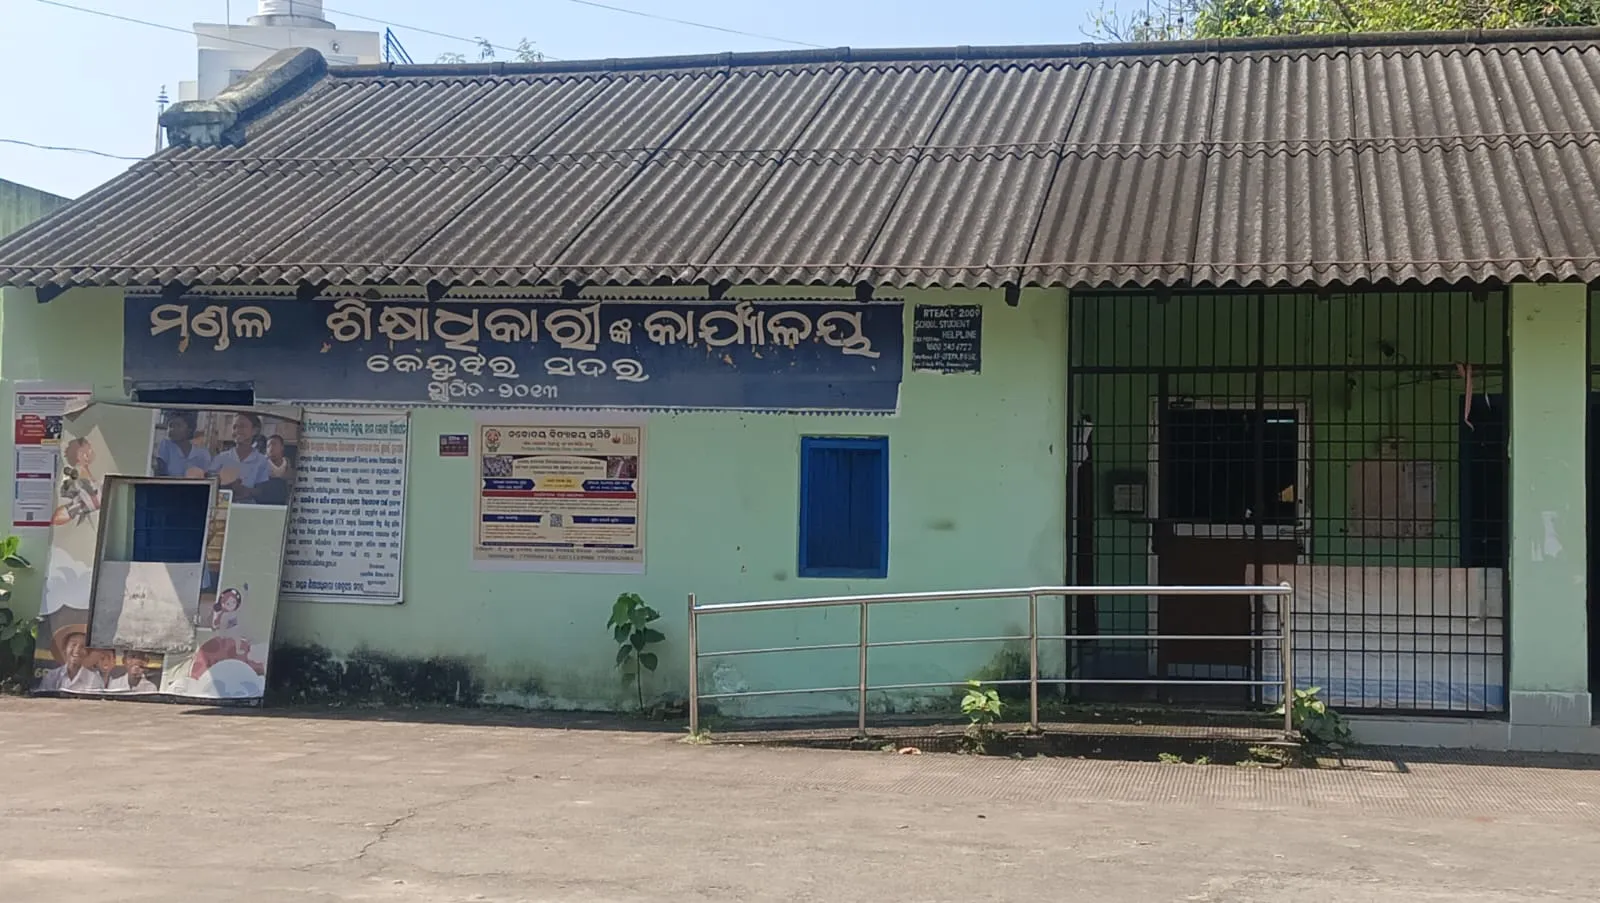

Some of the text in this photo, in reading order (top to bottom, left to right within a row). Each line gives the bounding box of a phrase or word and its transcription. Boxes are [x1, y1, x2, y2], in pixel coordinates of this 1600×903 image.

[959, 309, 980, 318] 2009
[150, 304, 272, 351] ମଣ୍ଡଳ
[939, 320, 970, 328] STUDENT
[942, 331, 977, 340] HELPLINE
[543, 357, 650, 382] ସଦର
